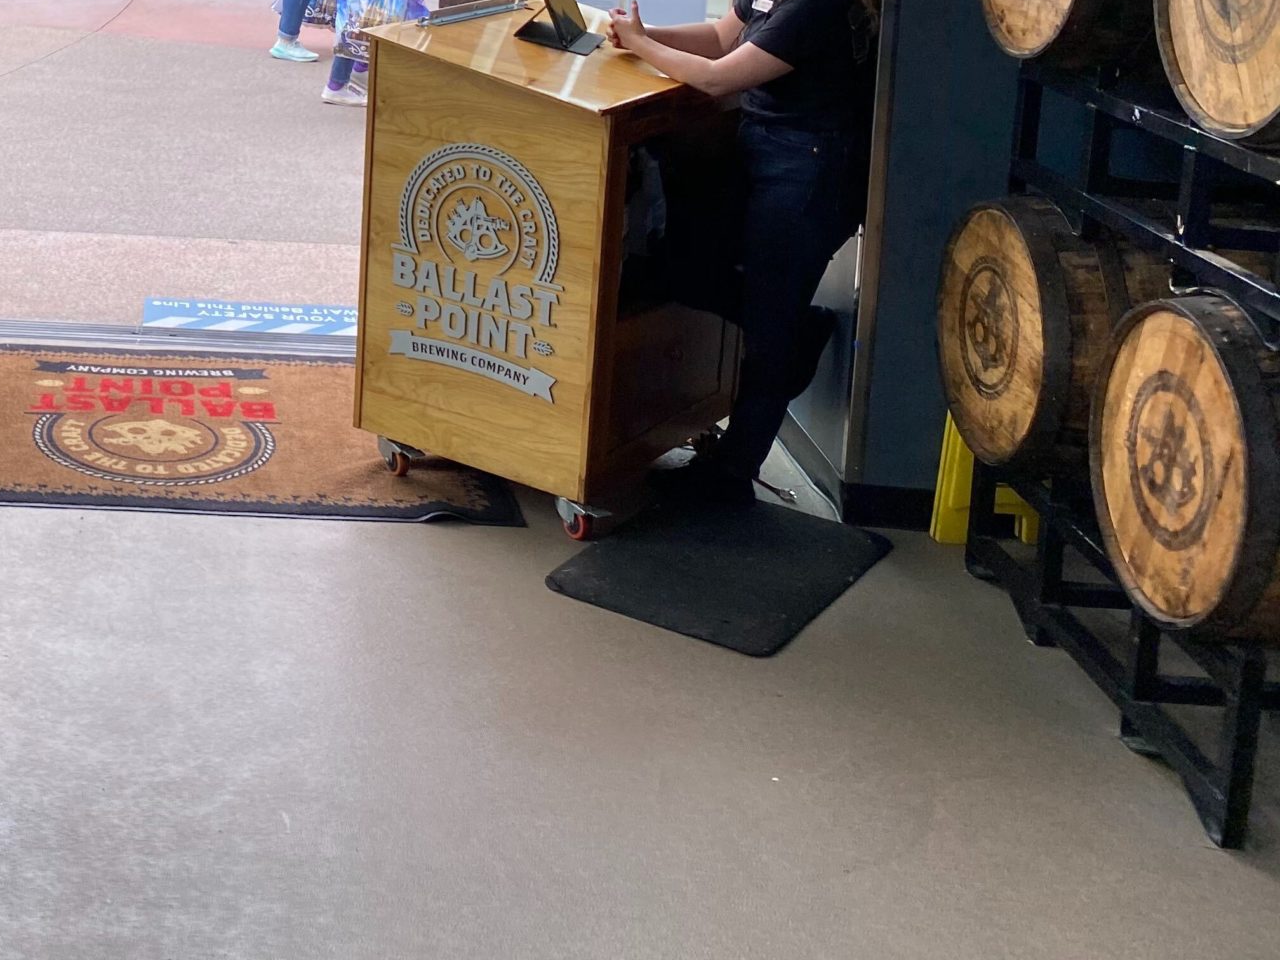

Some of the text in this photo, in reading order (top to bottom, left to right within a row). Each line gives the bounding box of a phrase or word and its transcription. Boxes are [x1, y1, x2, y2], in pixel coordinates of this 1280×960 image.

[417, 164, 539, 269] DEDICATED TO THE CRAFT
[392, 252, 560, 327] BALLAST
[152, 300, 357, 316] WAIT Behind This Line
[197, 310, 275, 320] SAFETY
[281, 313, 336, 323] YOUR
[416, 295, 536, 359] POINT
[67, 365, 235, 377] BREWING COMPANY
[412, 341, 530, 386] BREWING COMPANY
[63, 376, 233, 399] POINT
[28, 392, 278, 421] BALLAST
[61, 419, 248, 475] DEDICATED TO THE CRAFT
